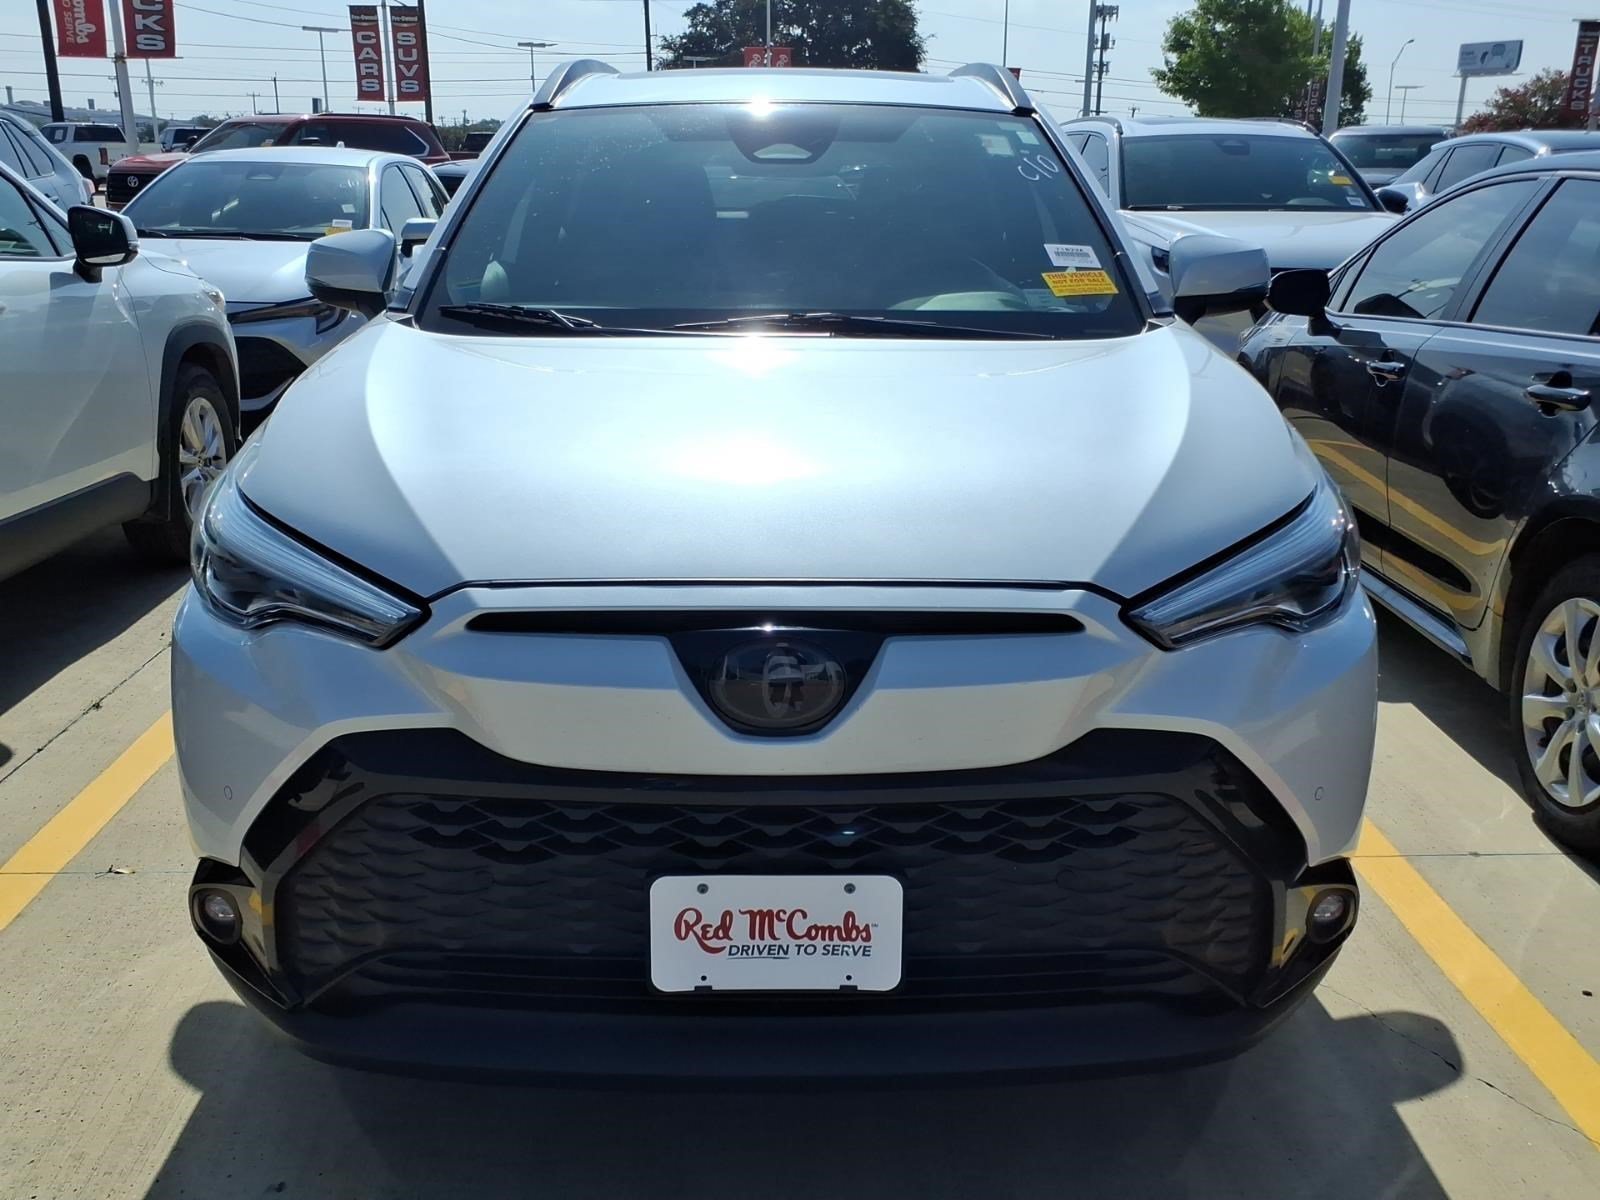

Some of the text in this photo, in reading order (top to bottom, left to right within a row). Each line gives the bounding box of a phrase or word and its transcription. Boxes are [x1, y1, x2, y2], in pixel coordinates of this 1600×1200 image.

[356, 31, 380, 92] CARS
[396, 31, 419, 93] SUVS
[1570, 44, 1594, 110] TRUCKS
[674, 907, 872, 954] Red McCombs
[728, 944, 872, 957] DRIVEN TO SERVE
